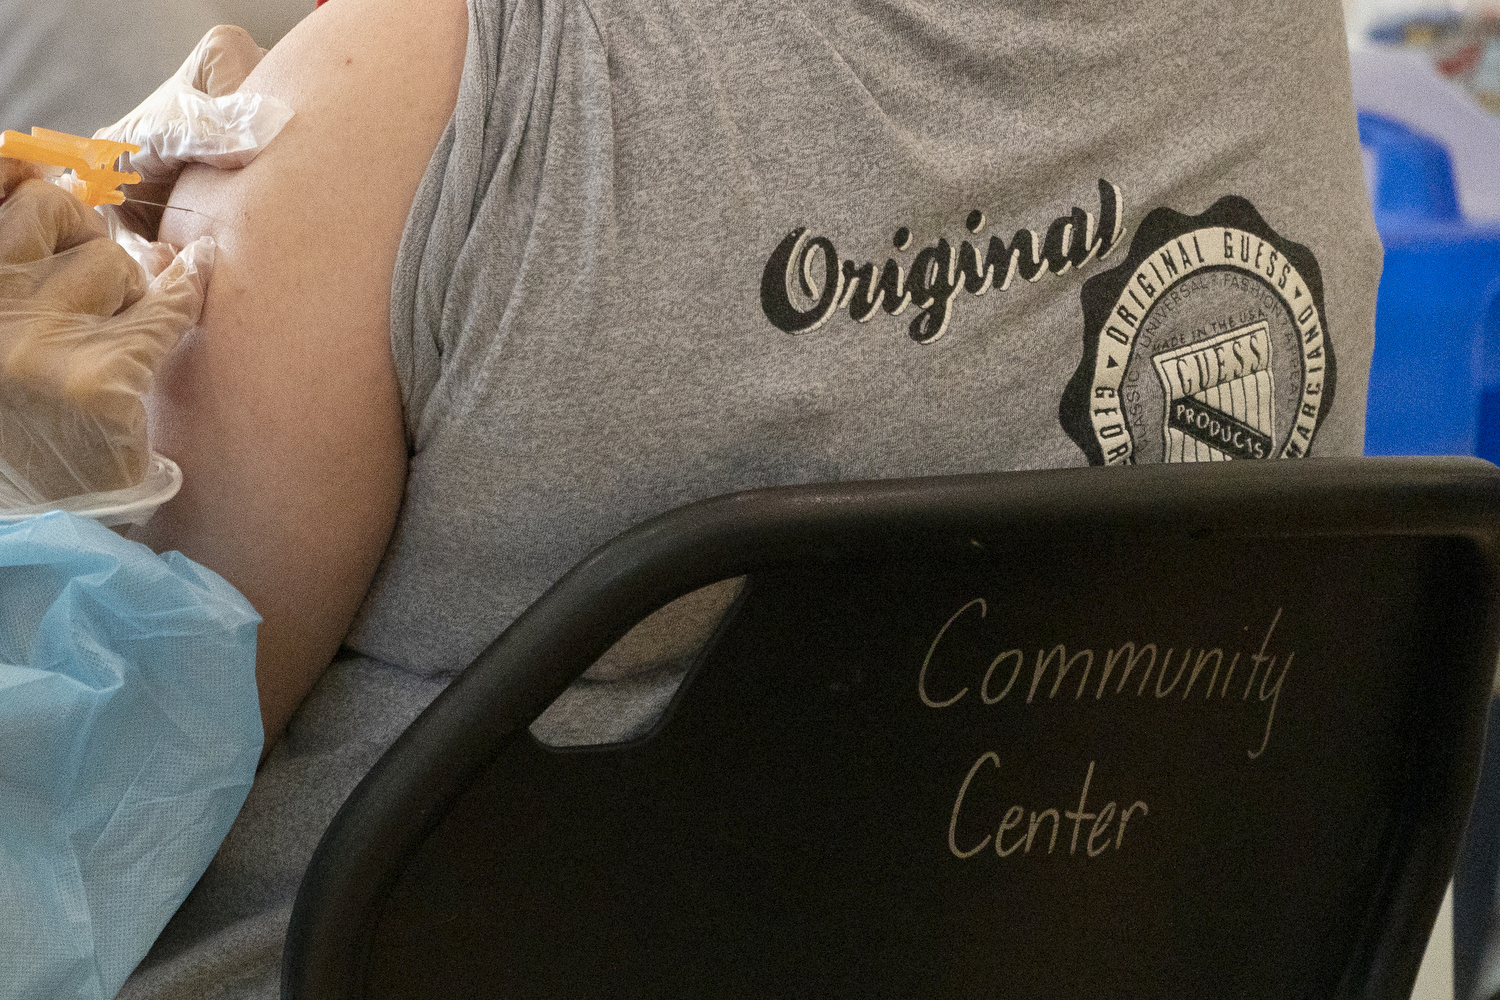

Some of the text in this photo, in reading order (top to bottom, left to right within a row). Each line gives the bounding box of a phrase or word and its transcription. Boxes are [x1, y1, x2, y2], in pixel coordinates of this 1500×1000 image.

[760, 178, 1127, 346] Original
[1106, 231, 1291, 346] ORIGINAL GUESS
[1176, 335, 1262, 396] GUESS
[1094, 386, 1134, 466] GEOR
[1176, 405, 1265, 459] PRODUCTS
[918, 598, 1296, 759] Community
[949, 751, 1148, 859] Center
